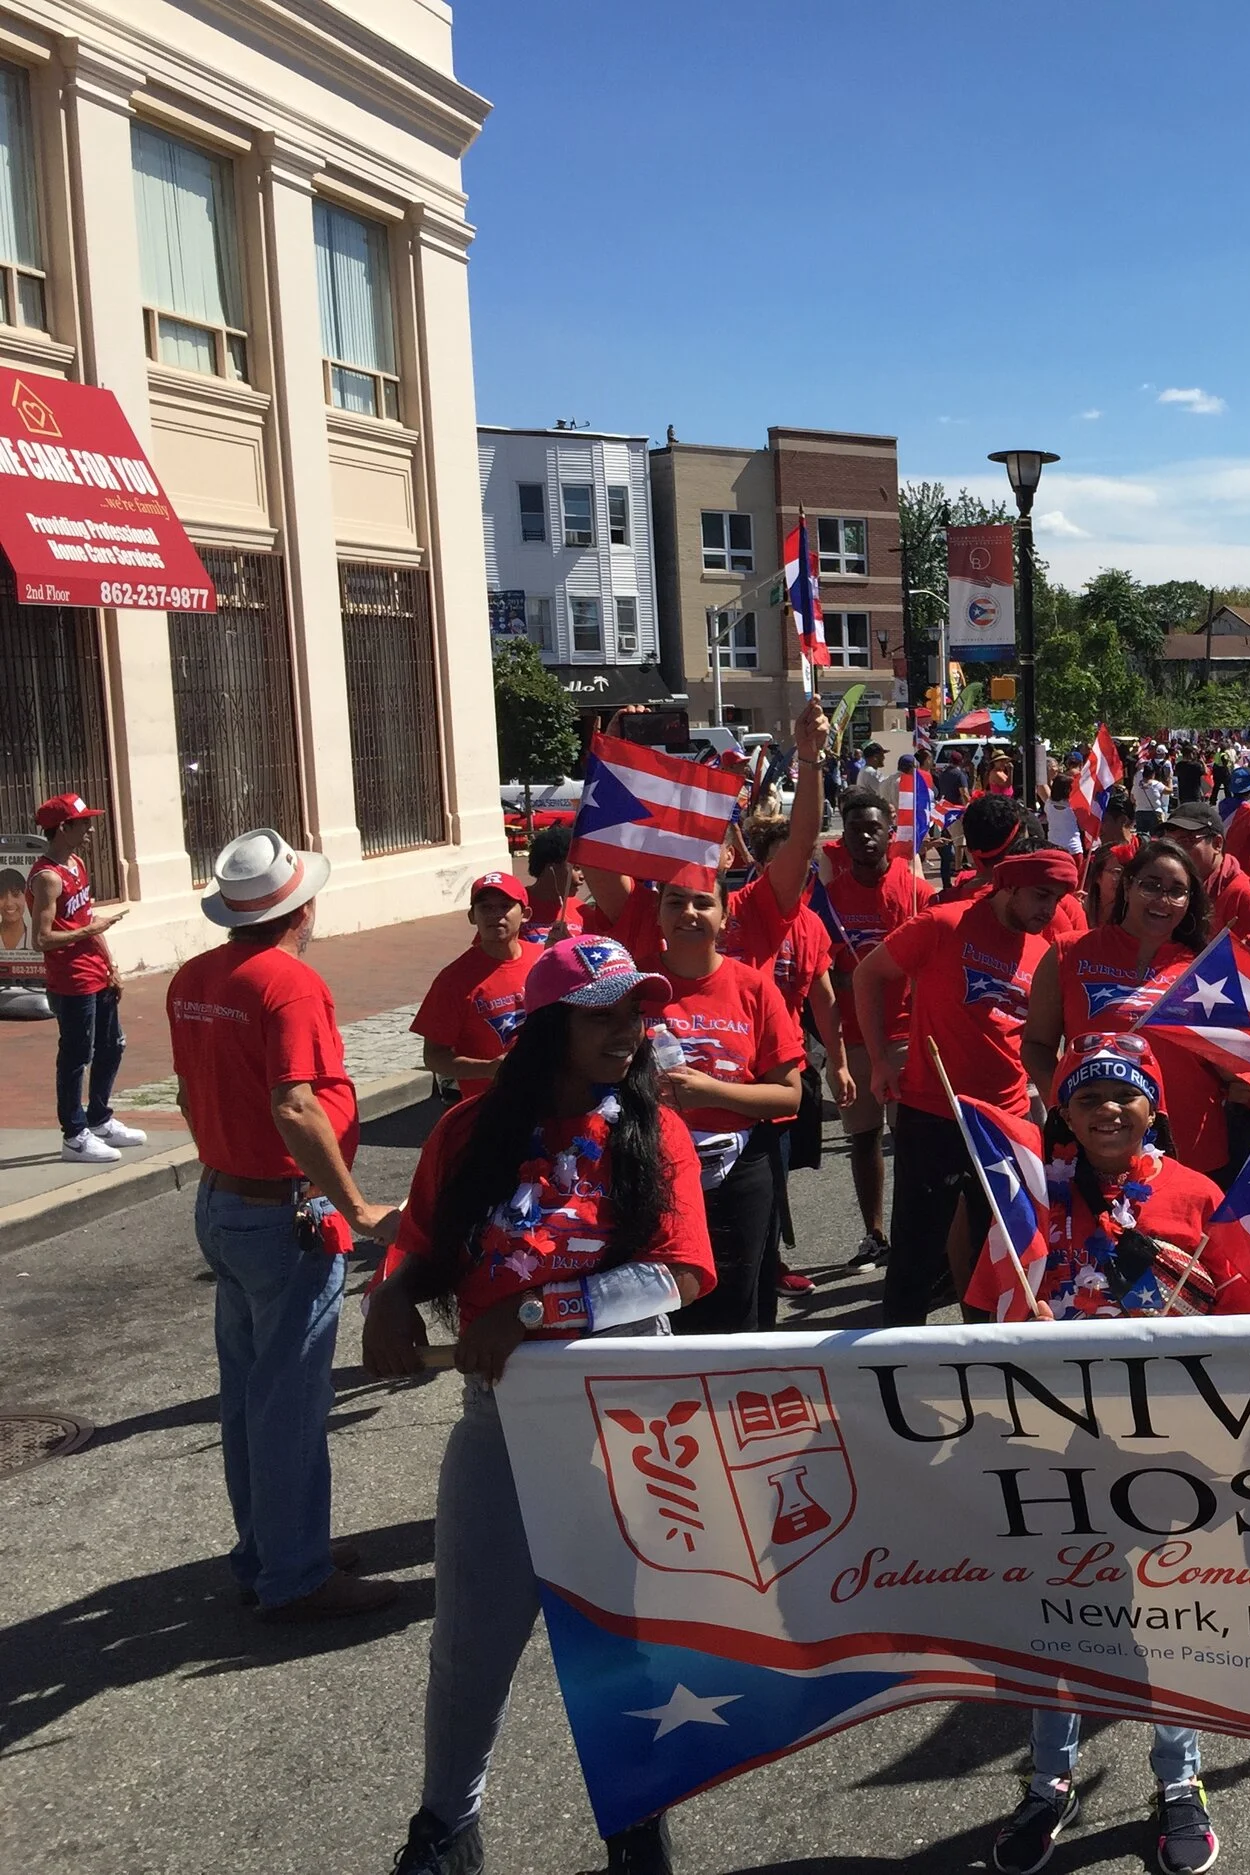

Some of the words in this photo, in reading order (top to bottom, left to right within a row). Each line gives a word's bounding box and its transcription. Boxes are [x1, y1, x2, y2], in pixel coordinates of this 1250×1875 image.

[17, 439, 84, 485] CARE
[69, 448, 120, 492] FOR
[108, 456, 159, 497] YOU
[135, 498, 170, 521] family
[26, 513, 91, 540] Providing
[88, 519, 160, 546] Professional
[47, 540, 87, 563] Home
[83, 545, 118, 565] Care
[114, 548, 165, 569] Services
[26, 584, 44, 600] 2nd
[47, 584, 70, 602] Floor
[100, 581, 208, 609] 862-237-9877
[9, 856, 25, 865] CARE
[483, 873, 503, 885] R
[962, 942, 1009, 973] PUERTO
[1077, 959, 1139, 983] PUERTO
[691, 1014, 749, 1035] RICAN
[1066, 1061, 1127, 1093] PUERTO
[1131, 1069, 1156, 1100] RICO
[830, 1547, 992, 1604] Saluda
[1002, 1566, 1033, 1584] a
[1055, 1542, 1127, 1586] La
[1040, 1597, 1229, 1636] Newark,
[1030, 1638, 1070, 1652] One
[1076, 1638, 1128, 1658] Goal.
[1133, 1645, 1175, 1662] One
